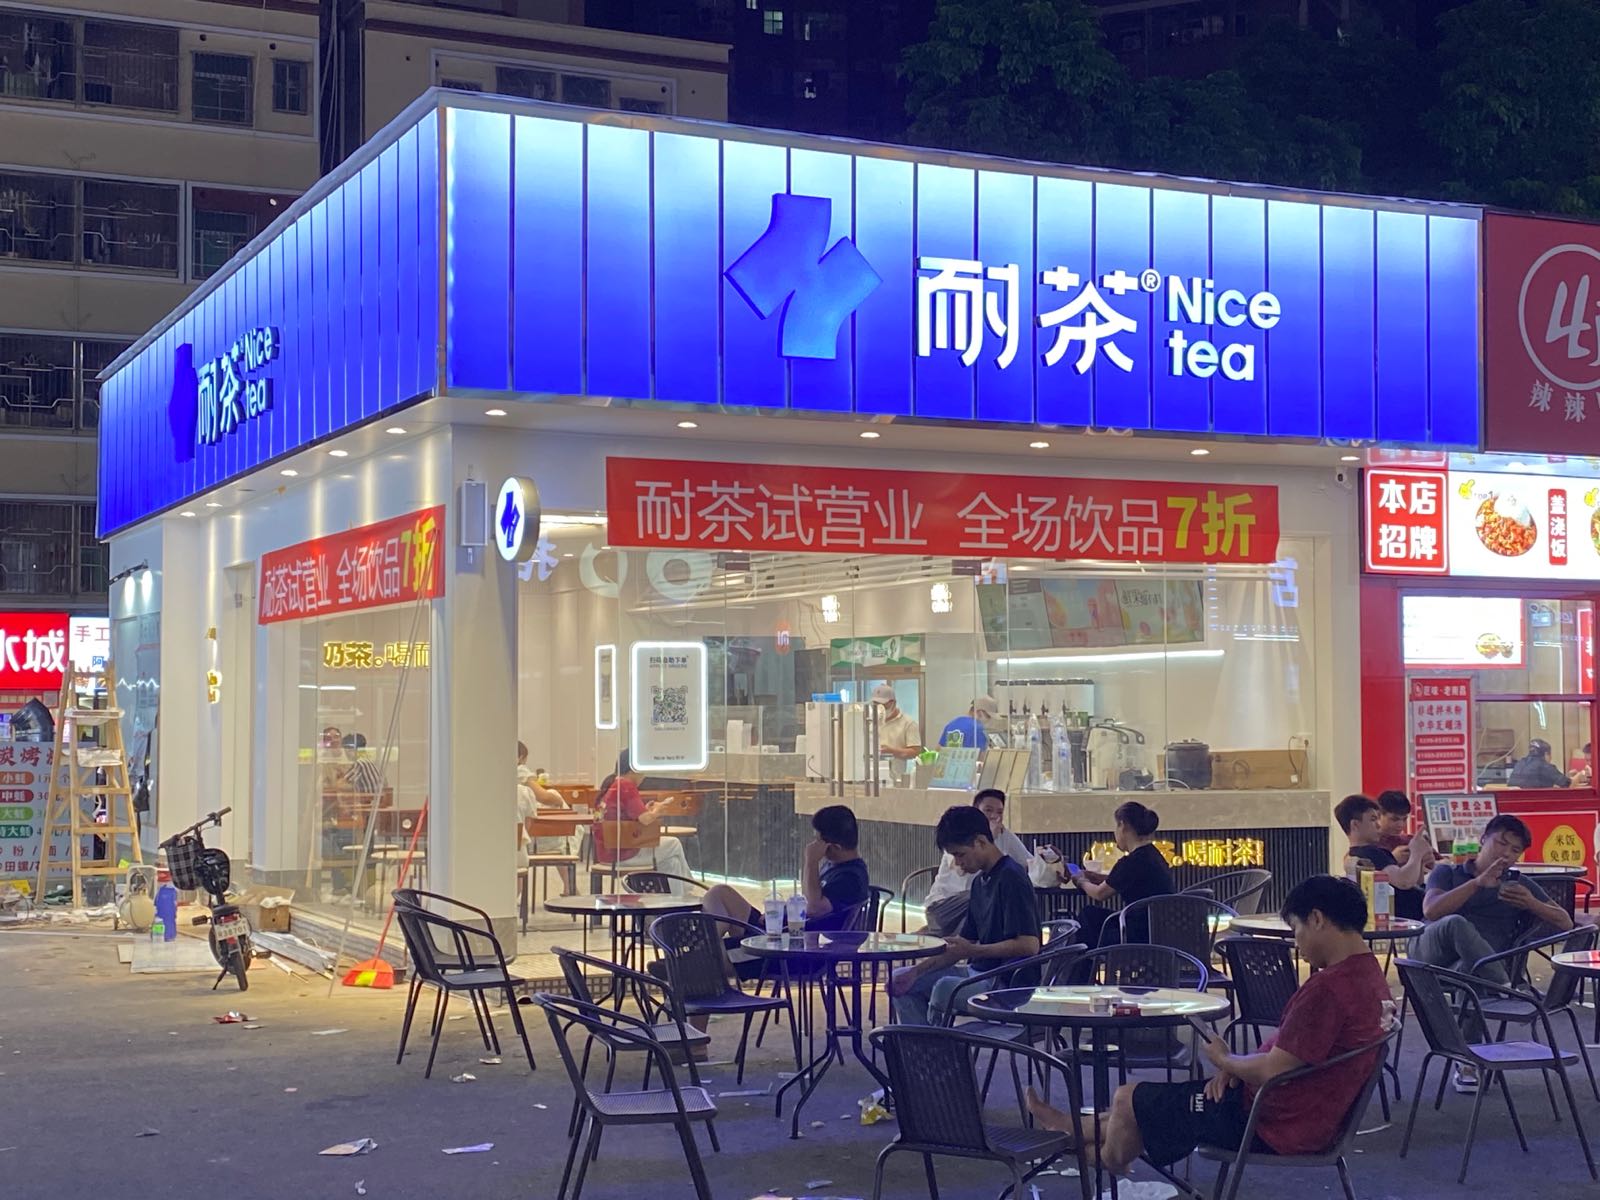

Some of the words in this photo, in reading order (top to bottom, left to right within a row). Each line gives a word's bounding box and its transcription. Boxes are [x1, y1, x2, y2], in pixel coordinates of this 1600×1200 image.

[1166, 274, 1282, 331] Nice
[244, 325, 273, 374] Nice
[1168, 329, 1256, 381] tea
[197, 340, 240, 446] 耐茶
[244, 376, 267, 421] tea
[1528, 379, 1600, 423] 辣辣
[635, 479, 928, 548] 耐茶试营业
[956, 490, 1257, 557] 全场饮品7折
[1378, 479, 1437, 515] 本店
[262, 554, 331, 617] 耐茶试营业
[336, 516, 437, 604] 全场饮品7折
[1378, 524, 1438, 561] 招牌
[74, 624, 110, 643] 手工
